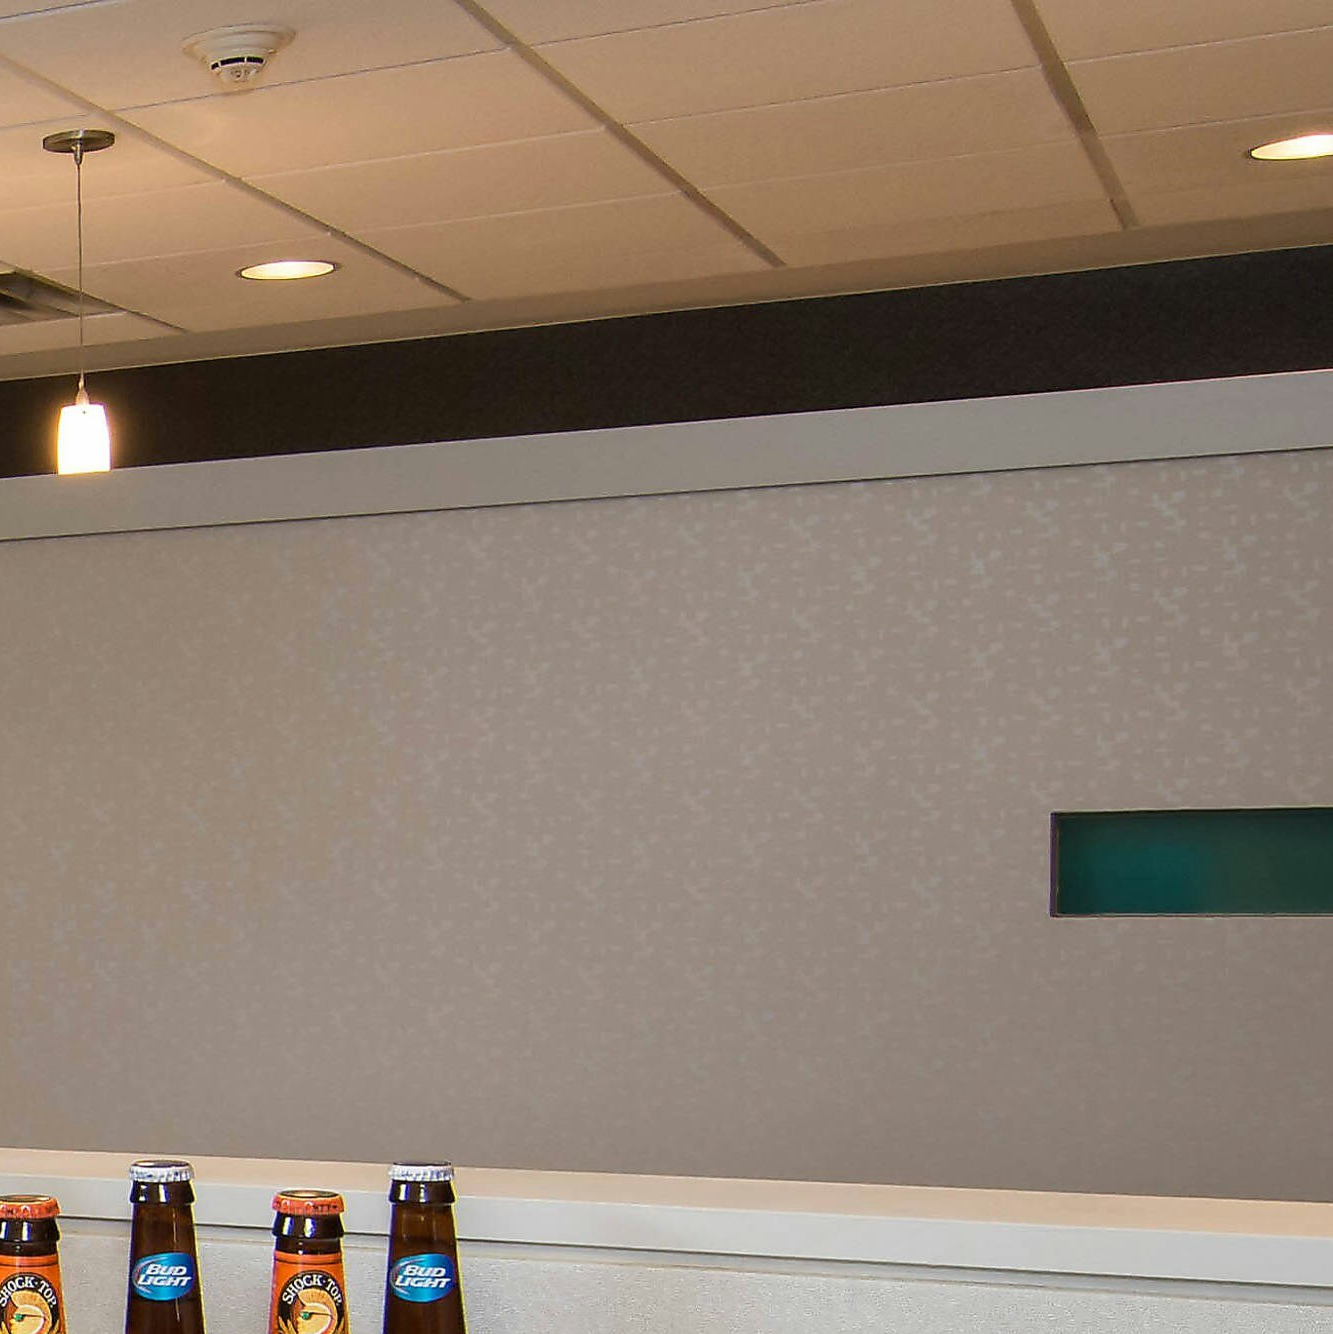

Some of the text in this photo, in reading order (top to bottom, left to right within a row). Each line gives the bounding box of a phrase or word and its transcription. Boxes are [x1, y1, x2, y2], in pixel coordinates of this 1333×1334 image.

[145, 1264, 187, 1276] BUD
[403, 1265, 446, 1277] BUD
[138, 1274, 192, 1287] LIGHT
[395, 1275, 451, 1288] LIGHT
[282, 1274, 323, 1305] SHOCK
